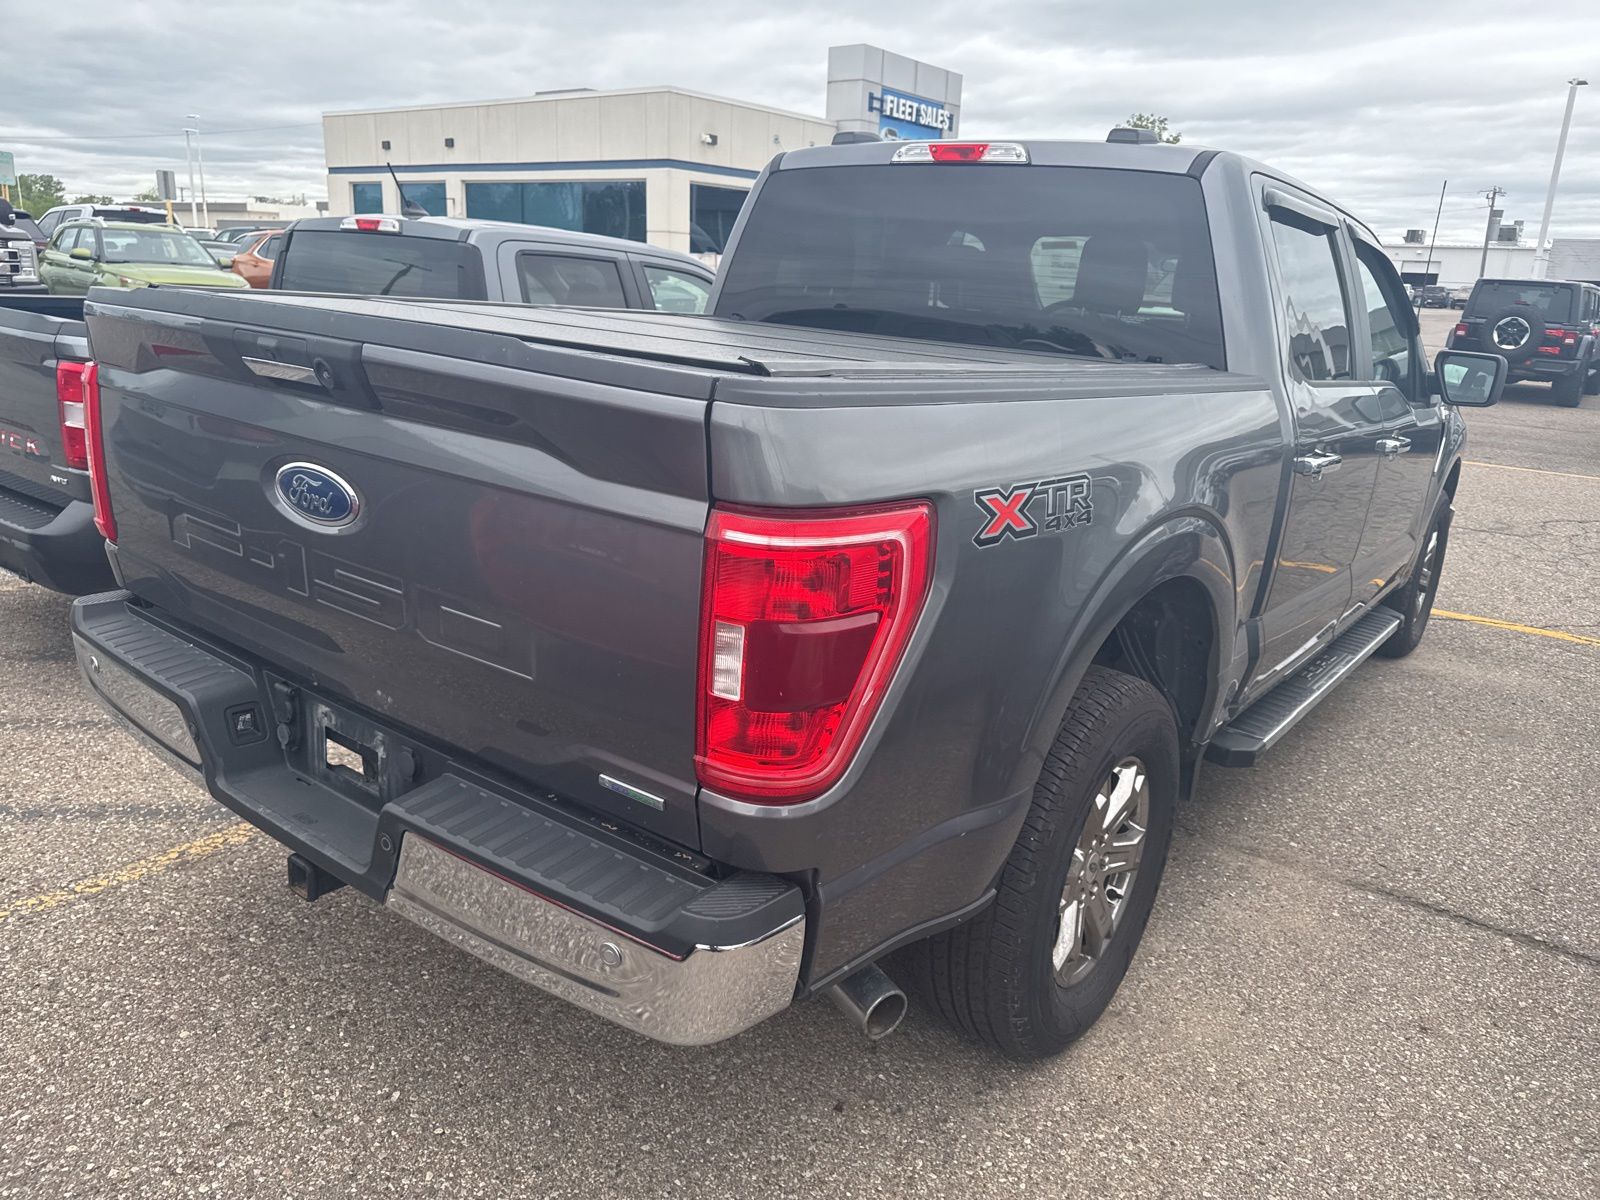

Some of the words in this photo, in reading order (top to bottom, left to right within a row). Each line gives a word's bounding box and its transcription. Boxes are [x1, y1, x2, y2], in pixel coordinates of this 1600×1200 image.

[886, 94, 919, 122] FLEET
[919, 105, 950, 130] SALES
[289, 473, 333, 514] Ford
[972, 471, 1094, 549] XTR
[171, 498, 537, 680] F-150
